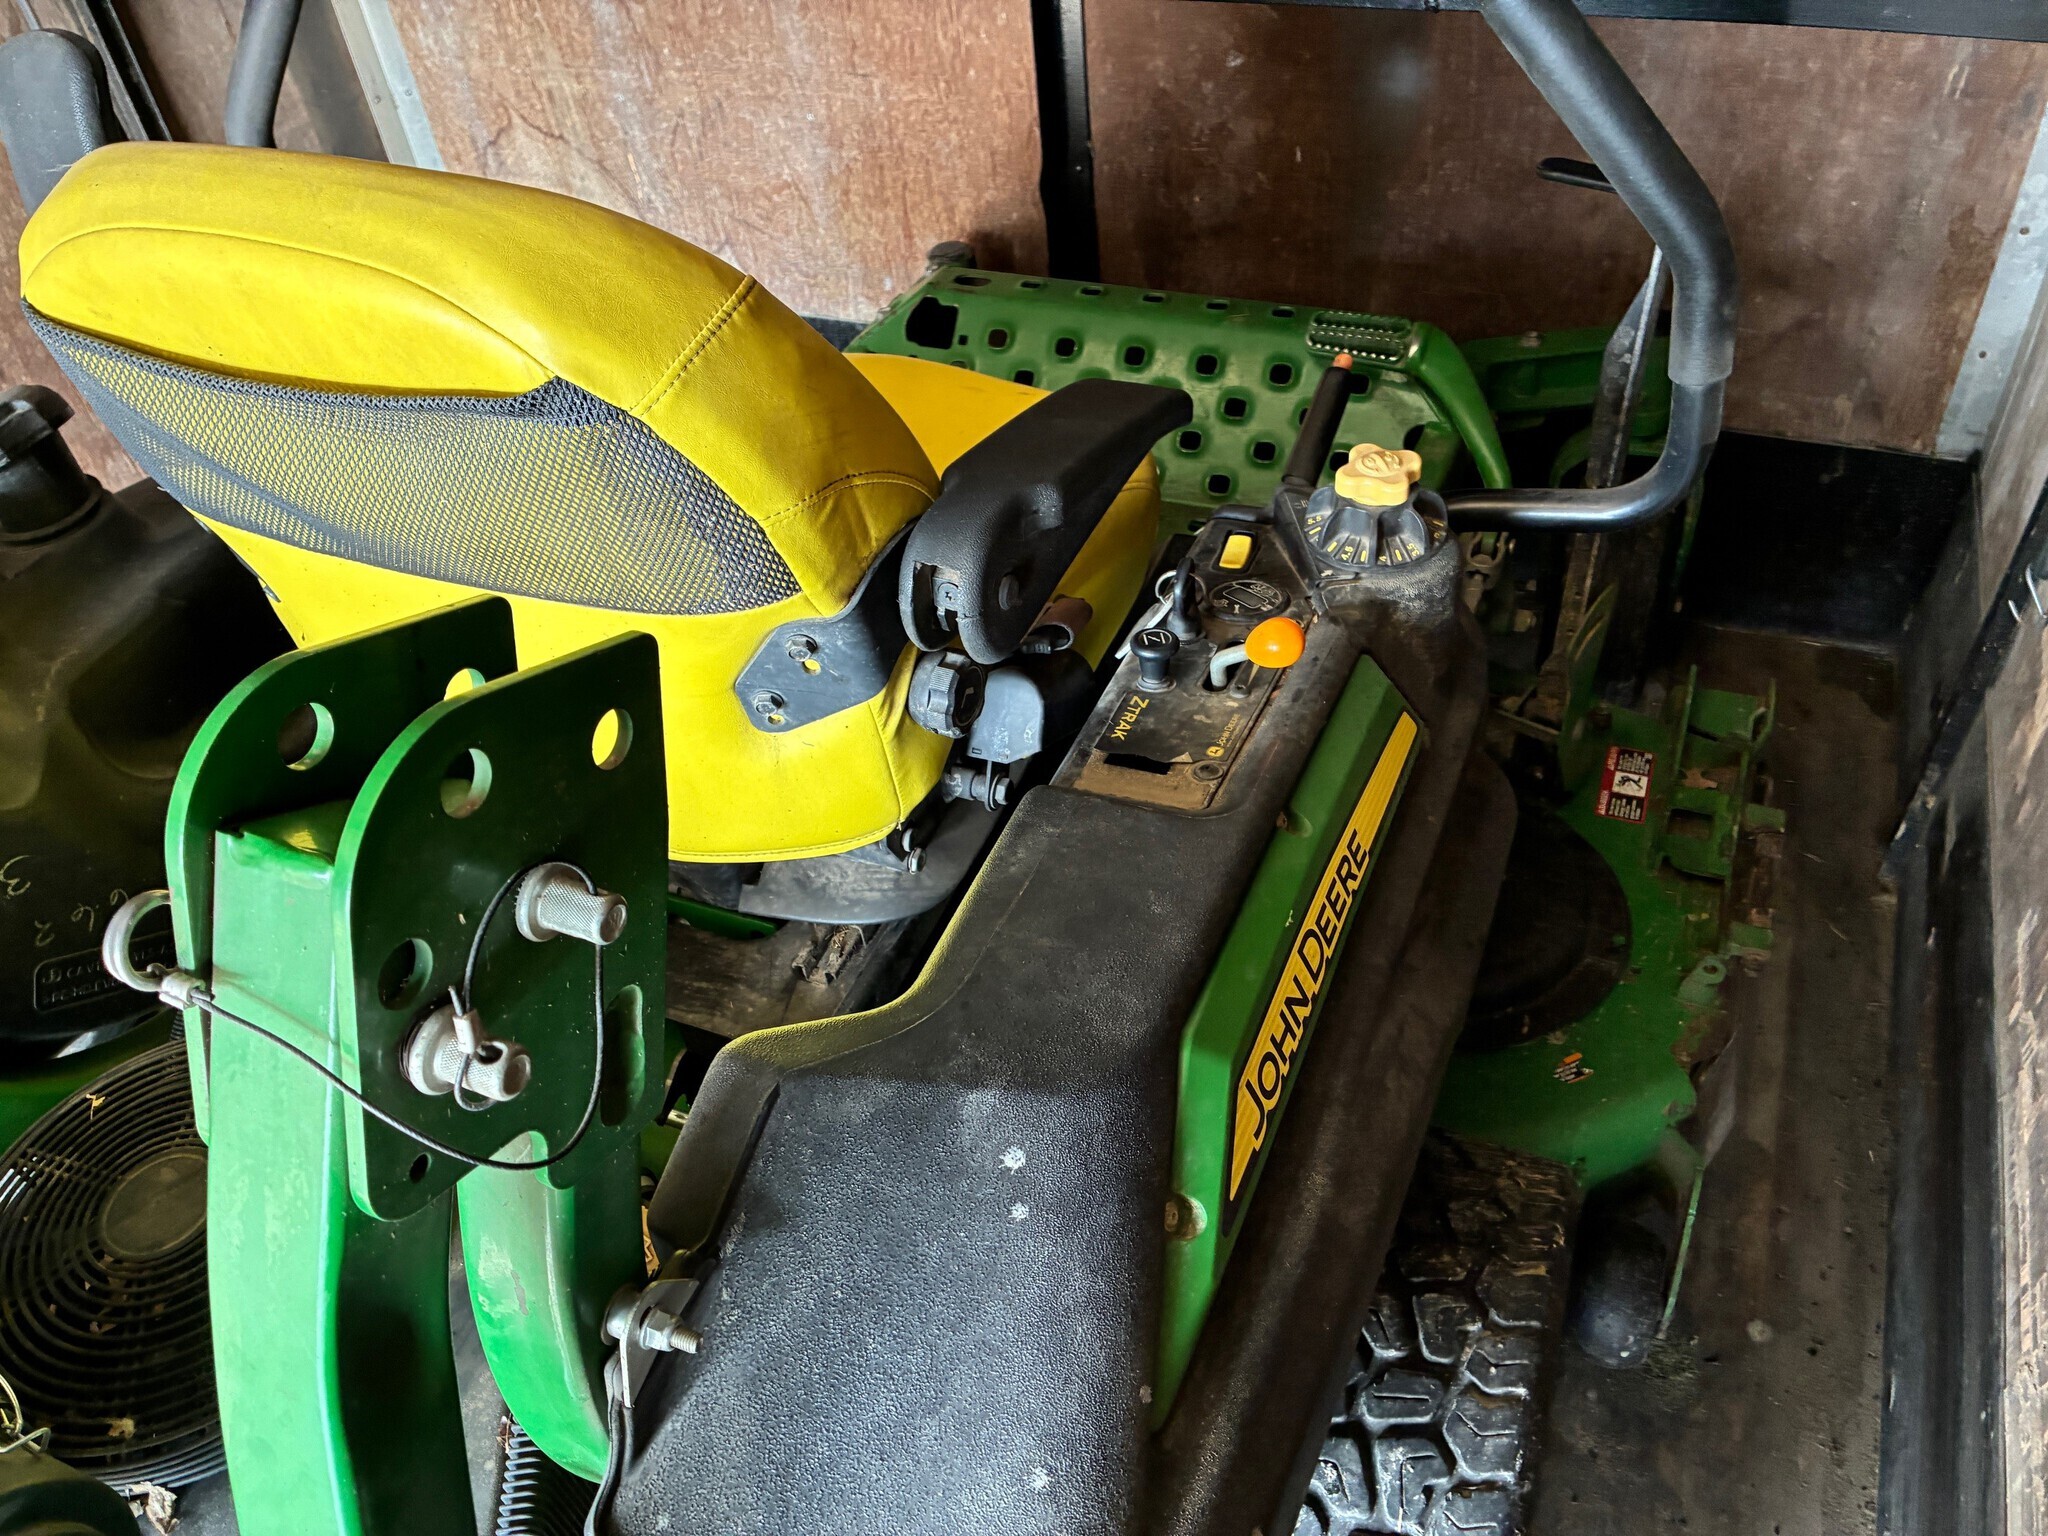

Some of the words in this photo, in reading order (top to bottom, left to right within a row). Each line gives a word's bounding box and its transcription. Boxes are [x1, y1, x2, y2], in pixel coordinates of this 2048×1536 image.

[1111, 695, 1149, 741] ZTRAK
[1245, 975, 1311, 1140] JOHN
[1298, 828, 1368, 985] DEERE
